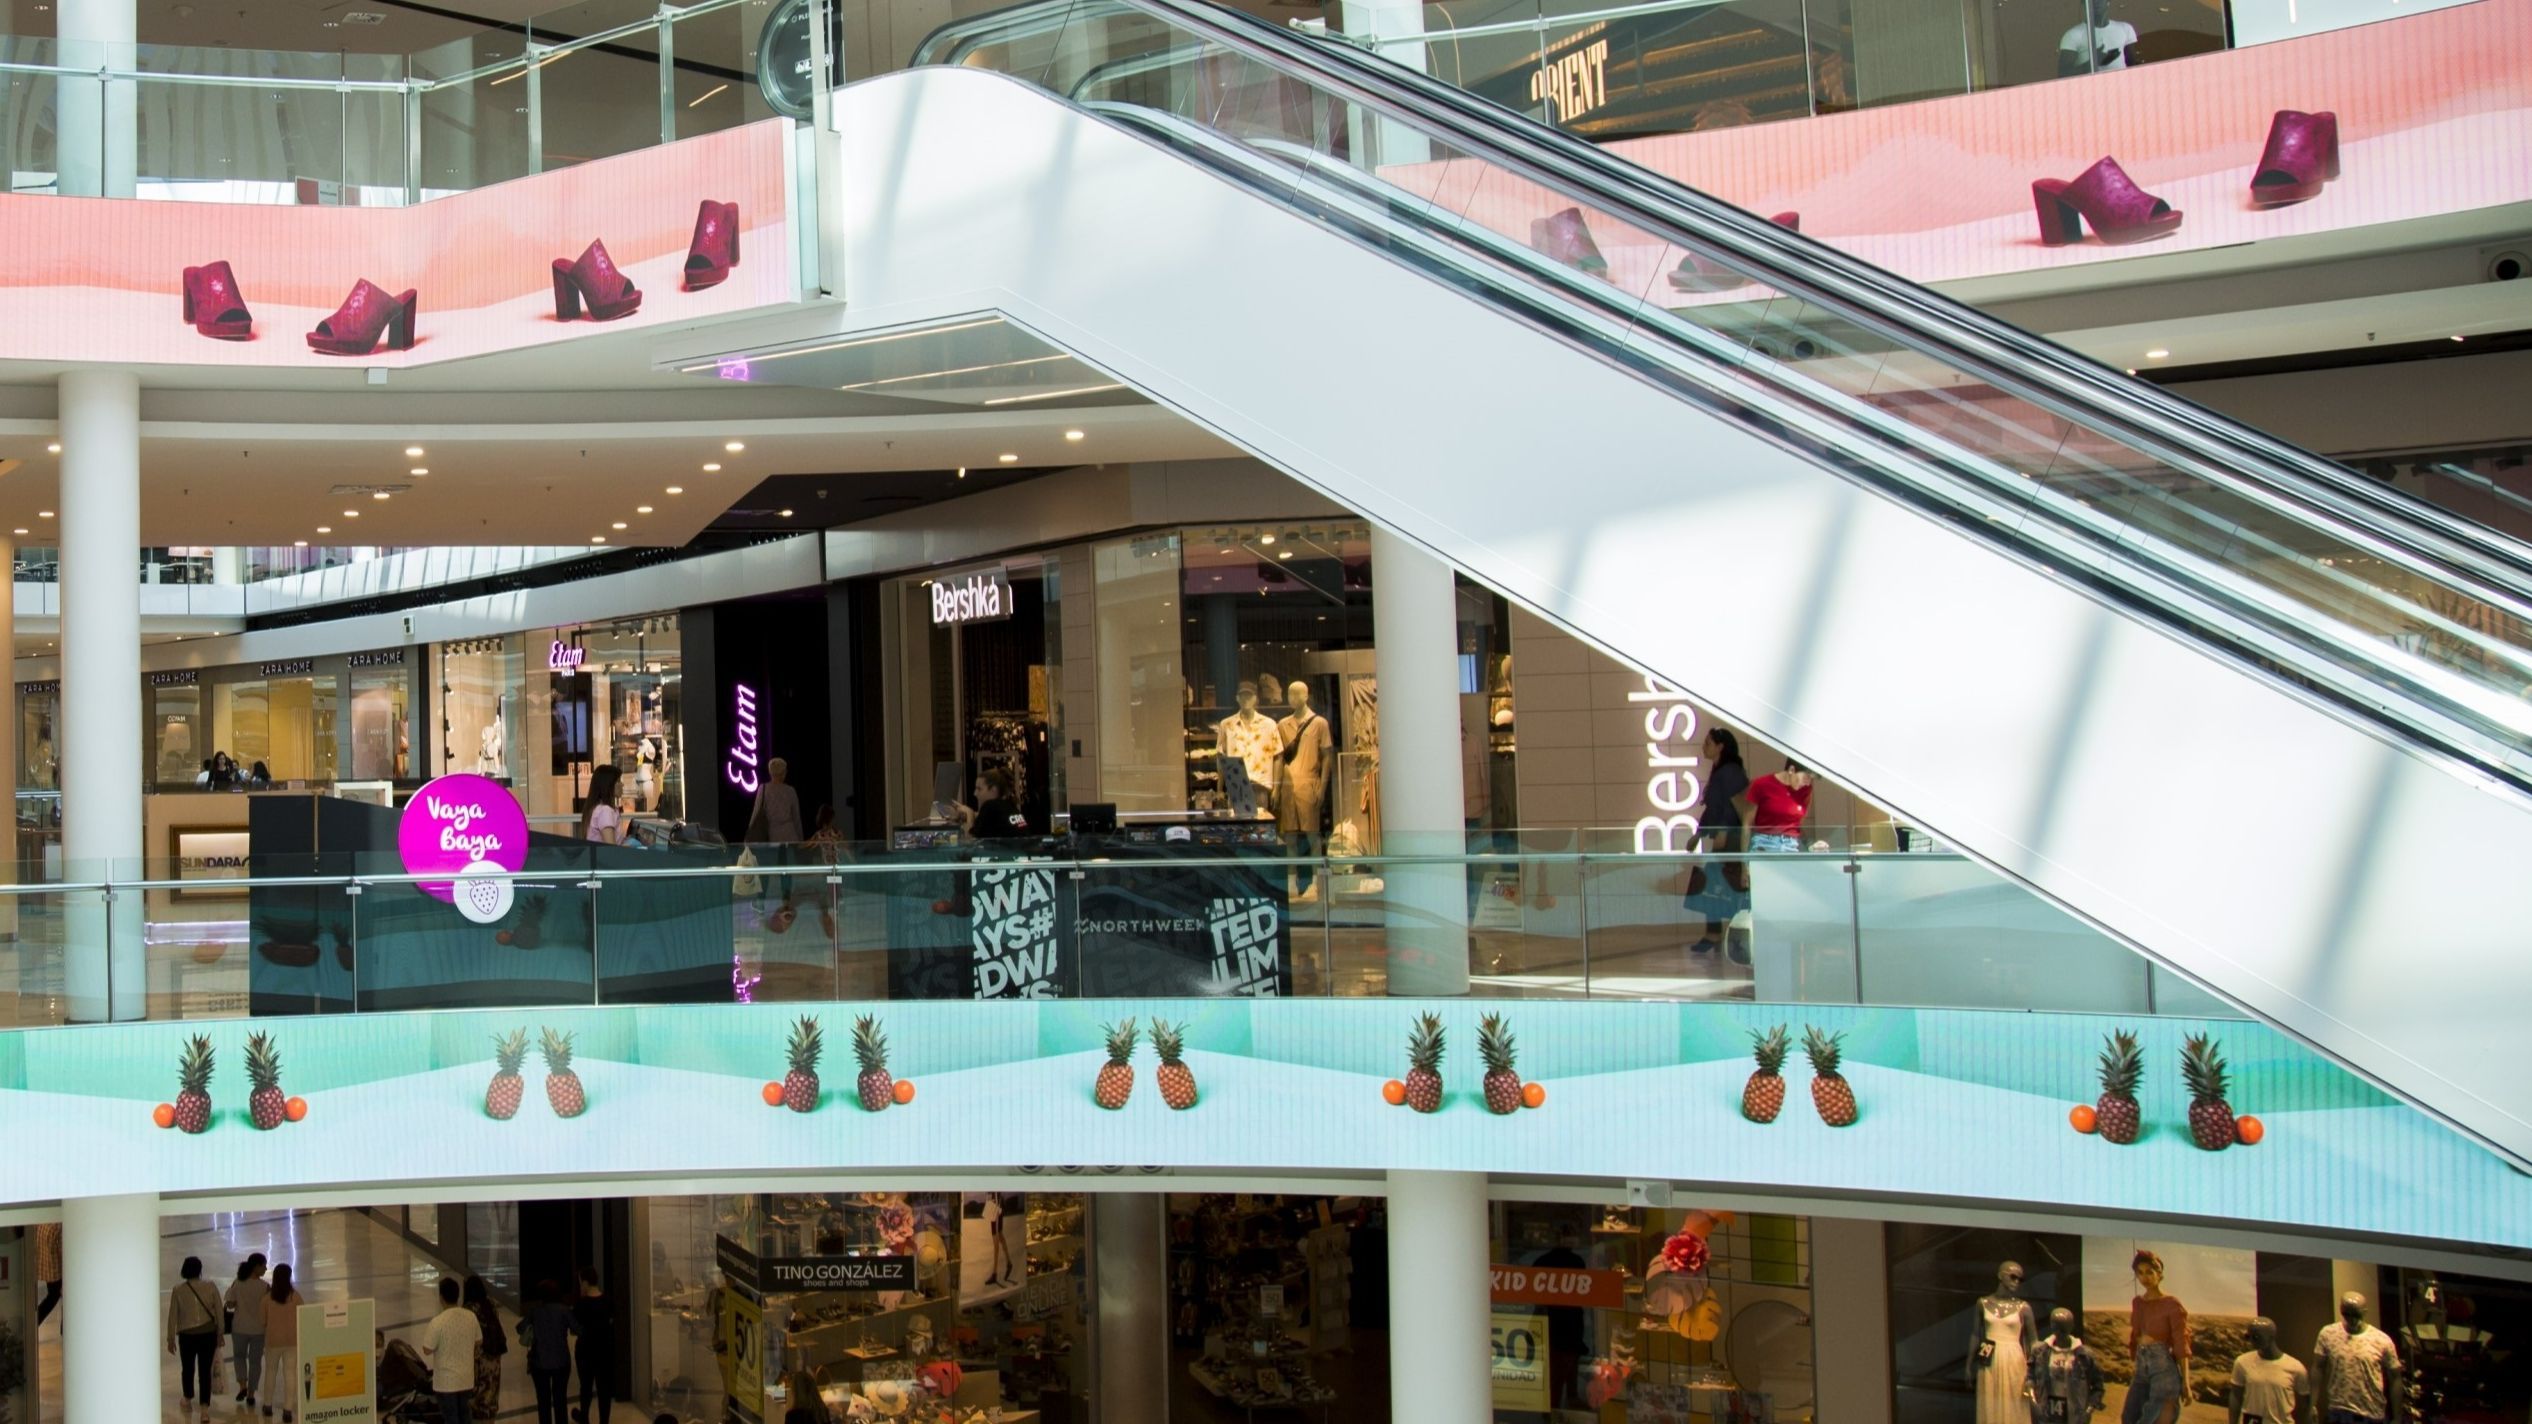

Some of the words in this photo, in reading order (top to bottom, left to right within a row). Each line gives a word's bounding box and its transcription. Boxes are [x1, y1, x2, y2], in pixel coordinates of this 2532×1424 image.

[1531, 39, 1607, 123] ORIENT
[932, 575, 1000, 623] Bershka
[347, 656, 372, 668] ZARA
[375, 651, 401, 664] HOME
[550, 641, 583, 668] Etam
[151, 674, 171, 685] ZARA
[174, 671, 196, 682] HOME
[260, 665, 282, 676] ZARA
[286, 661, 311, 673] HOME
[23, 684, 42, 694] ZARA
[45, 682, 60, 693] HOM
[728, 684, 758, 792] Etam
[1628, 675, 1703, 854] Bersh
[427, 796, 486, 831] Vaya
[773, 1265, 814, 1280] TINO
[816, 1261, 904, 1280] GONZÁLEZ
[803, 1279, 826, 1287] shoes
[828, 1279, 844, 1287] and
[845, 1279, 870, 1288] shops
[1533, 1272, 1593, 1295] CLUB
[305, 1408, 339, 1422] amazon
[340, 1405, 370, 1417] locker
